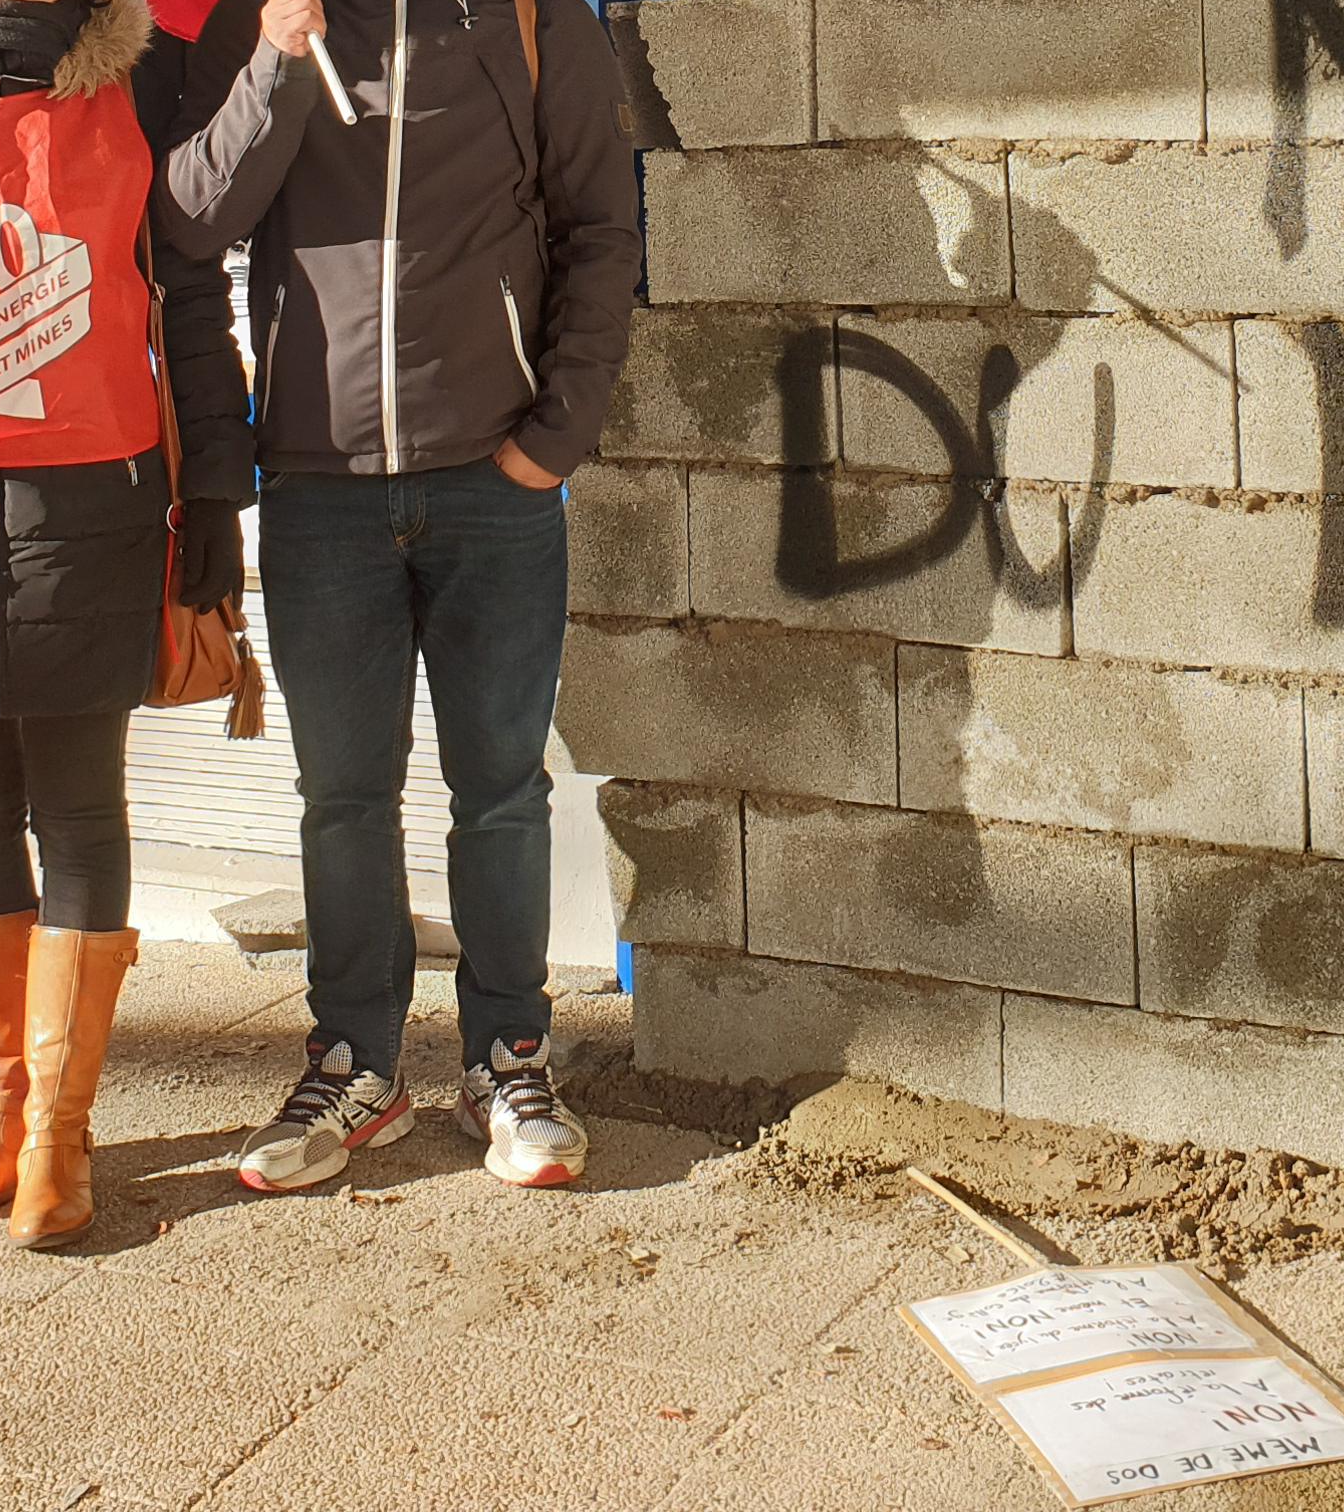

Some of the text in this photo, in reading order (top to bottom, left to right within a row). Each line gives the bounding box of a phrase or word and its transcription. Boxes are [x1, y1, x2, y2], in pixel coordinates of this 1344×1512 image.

[16, 314, 74, 365] MINES
[776, 323, 1116, 613] DU
[1203, 1382, 1242, 1396] la
[1071, 1396, 1107, 1411] des
[1175, 1453, 1213, 1473] DE
[1106, 1464, 1160, 1485] DOS
